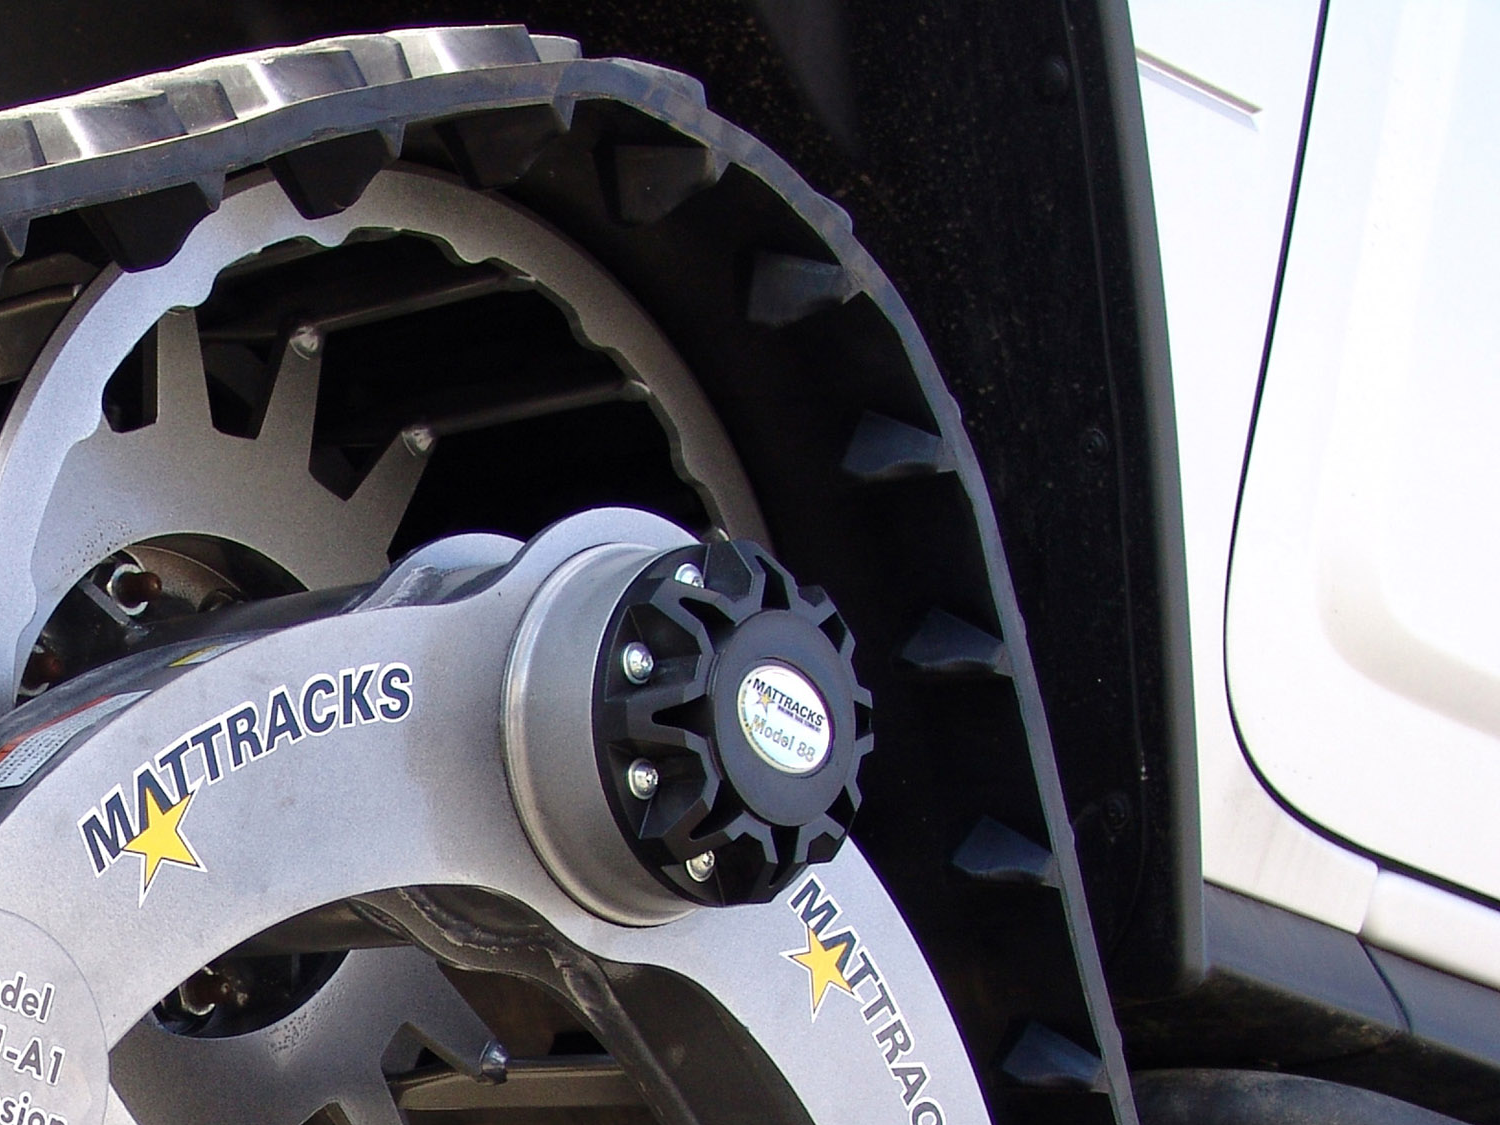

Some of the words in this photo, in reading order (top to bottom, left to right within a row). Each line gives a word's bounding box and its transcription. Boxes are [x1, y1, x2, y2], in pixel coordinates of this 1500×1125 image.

[752, 678, 823, 726] MATTRACKS
[752, 714, 795, 750] Model
[797, 741, 816, 762] 88
[79, 664, 413, 876] MATTRACKS
